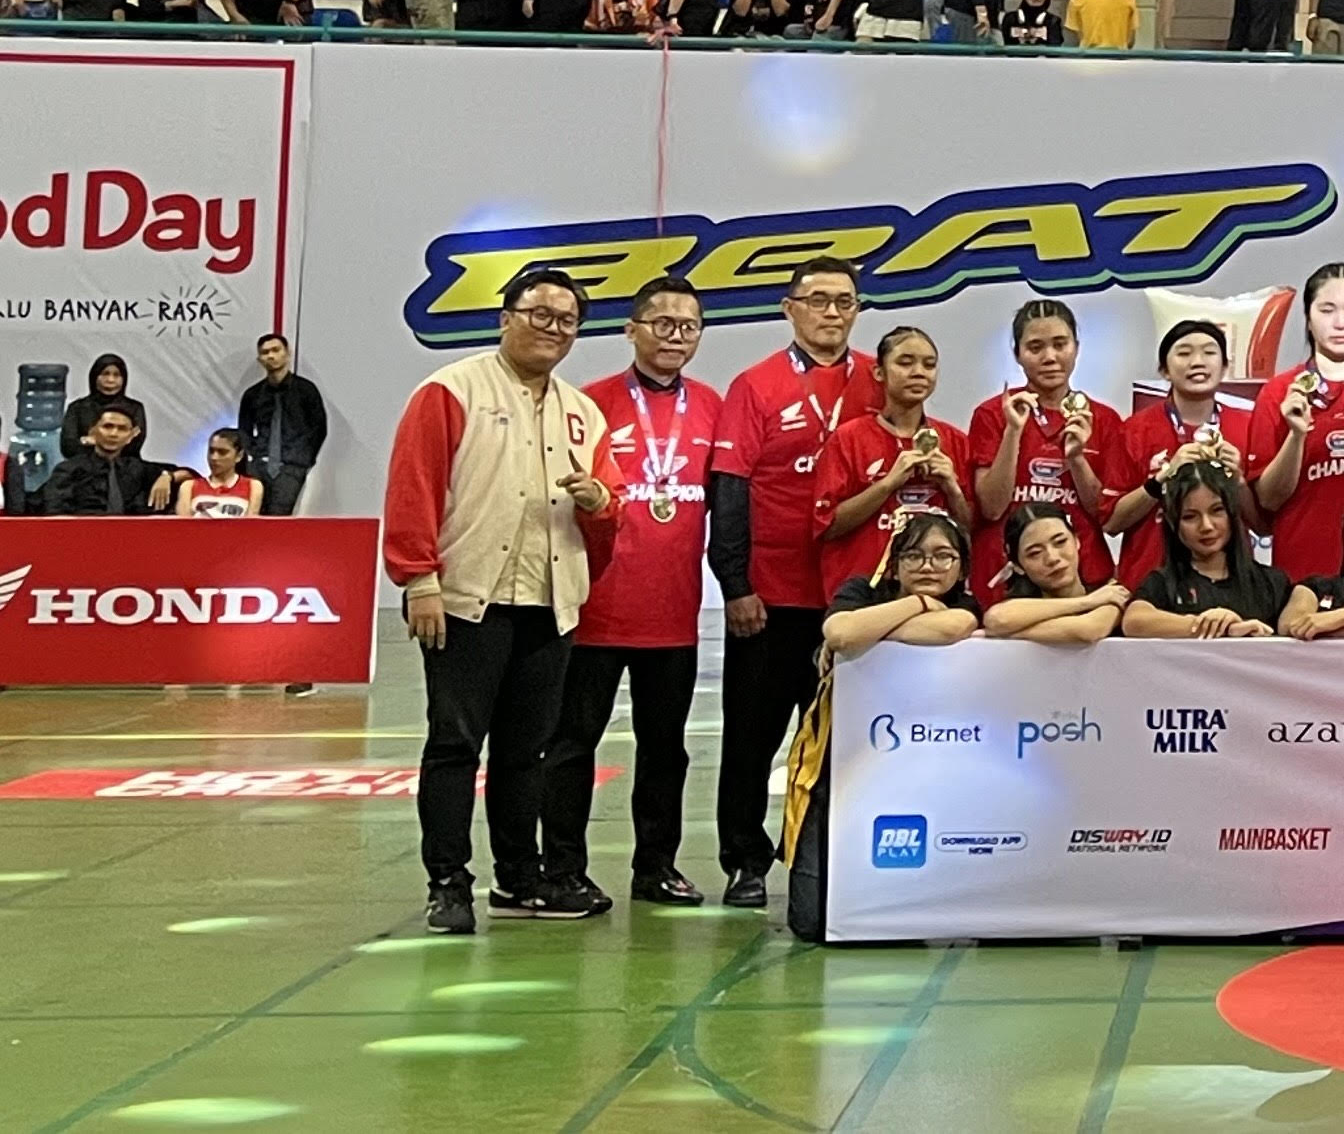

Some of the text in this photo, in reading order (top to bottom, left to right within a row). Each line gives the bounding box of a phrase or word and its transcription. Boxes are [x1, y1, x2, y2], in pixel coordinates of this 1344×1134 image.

[44, 299, 140, 323] BANYAK
[157, 300, 215, 324] RASA
[567, 412, 585, 446] G
[28, 586, 341, 626] HONDA
[1146, 708, 1228, 732] ULTRA
[911, 723, 982, 743] Biznet
[1018, 707, 1102, 759] posh
[1153, 730, 1219, 754] MILK
[878, 828, 922, 848] DBL
[1070, 829, 1172, 845] DISWAY.ID
[1218, 827, 1331, 852] MAINBASKET
[876, 846, 919, 859] PLAY
